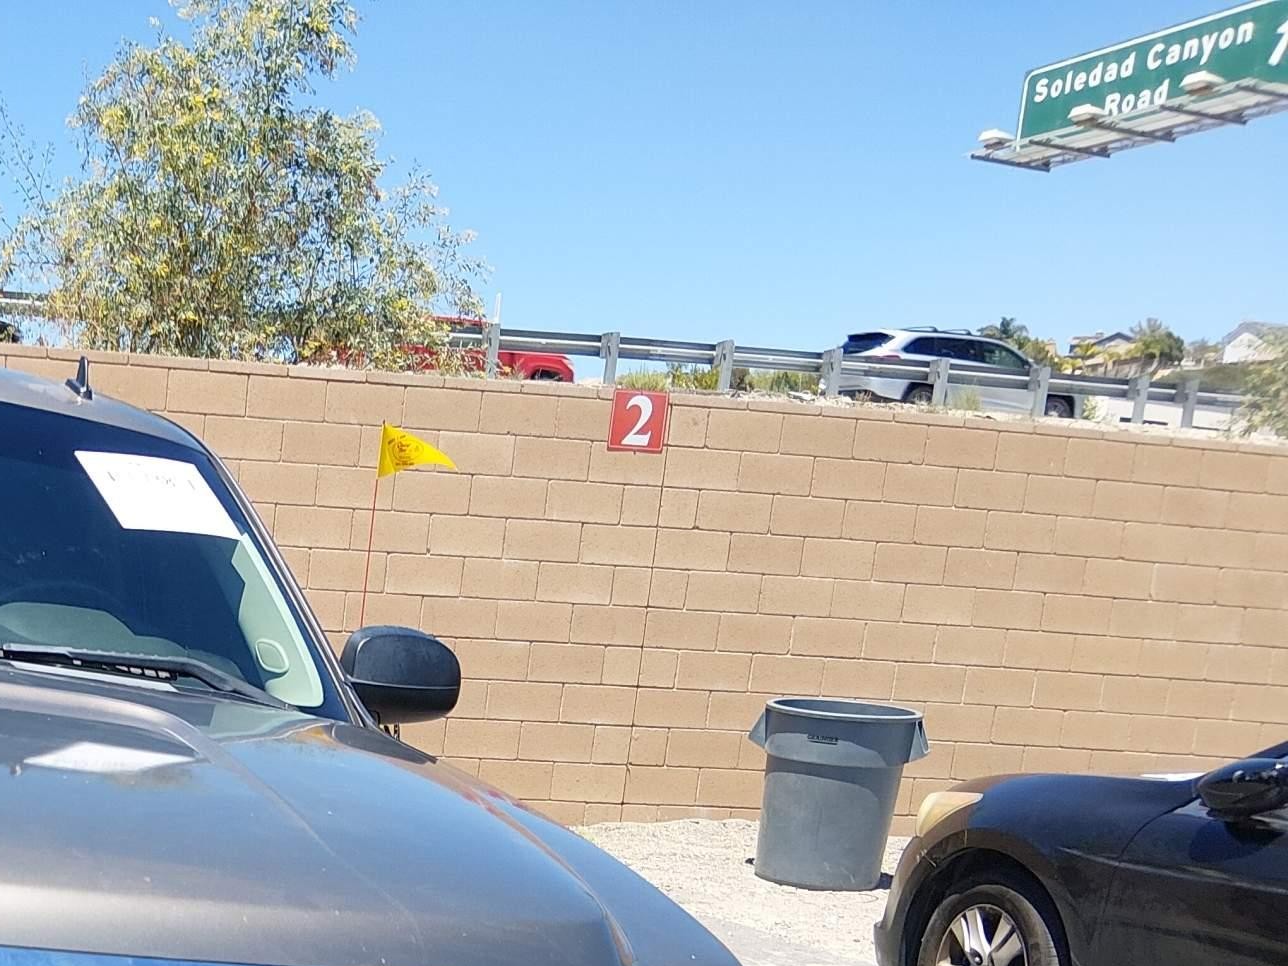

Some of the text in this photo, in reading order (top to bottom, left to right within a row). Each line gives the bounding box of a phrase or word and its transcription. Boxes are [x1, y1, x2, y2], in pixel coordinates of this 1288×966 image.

[1034, 21, 1256, 103] Soledad Canyon
[1103, 78, 1170, 116] Road
[620, 395, 653, 446] 2
